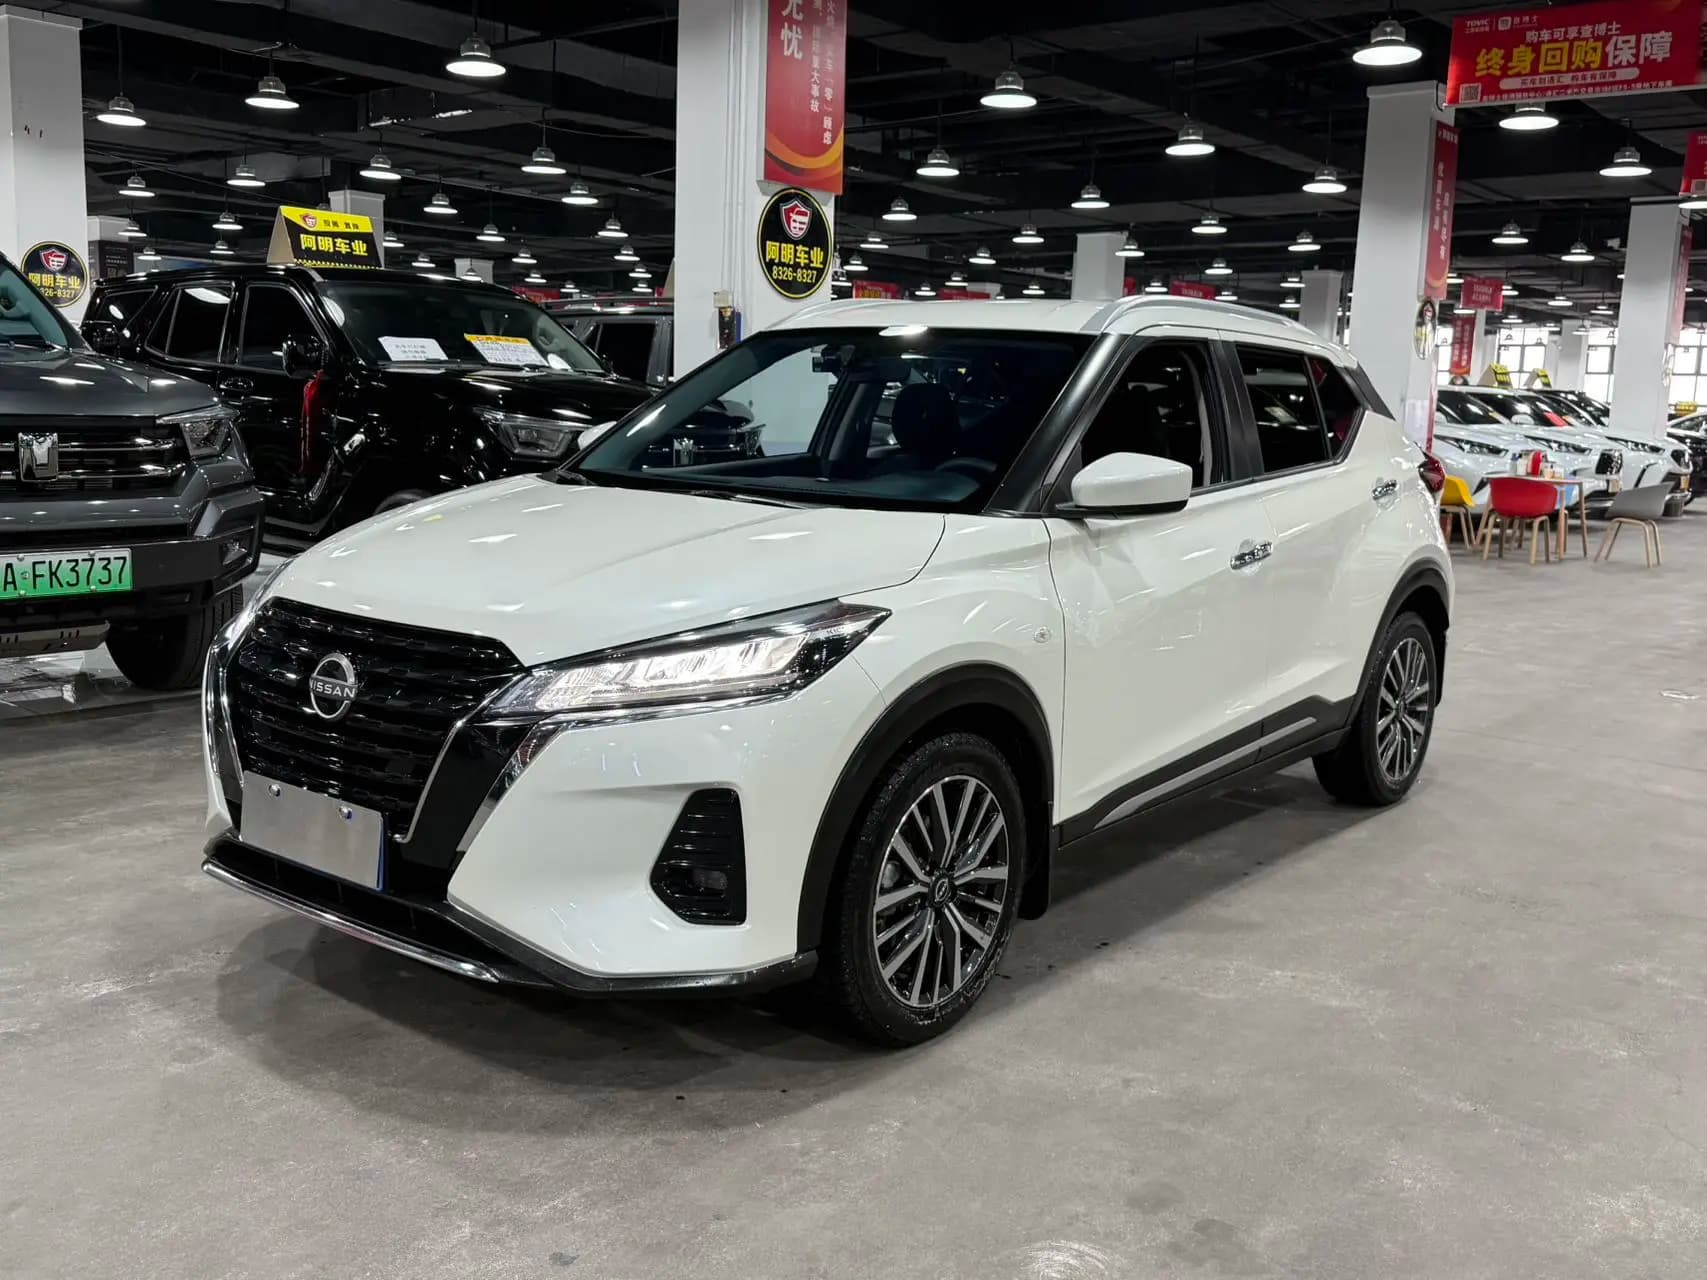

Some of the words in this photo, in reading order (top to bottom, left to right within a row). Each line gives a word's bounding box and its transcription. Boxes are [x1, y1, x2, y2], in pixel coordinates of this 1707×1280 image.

[1525, 21, 1622, 44] 购车可享查博士
[1474, 31, 1673, 77] 终身回购保障
[300, 234, 368, 256] 阿明车业
[766, 240, 824, 268] 阿明车业
[28, 272, 81, 289] 阿明车业
[772, 266, 817, 283] 8326-8327
